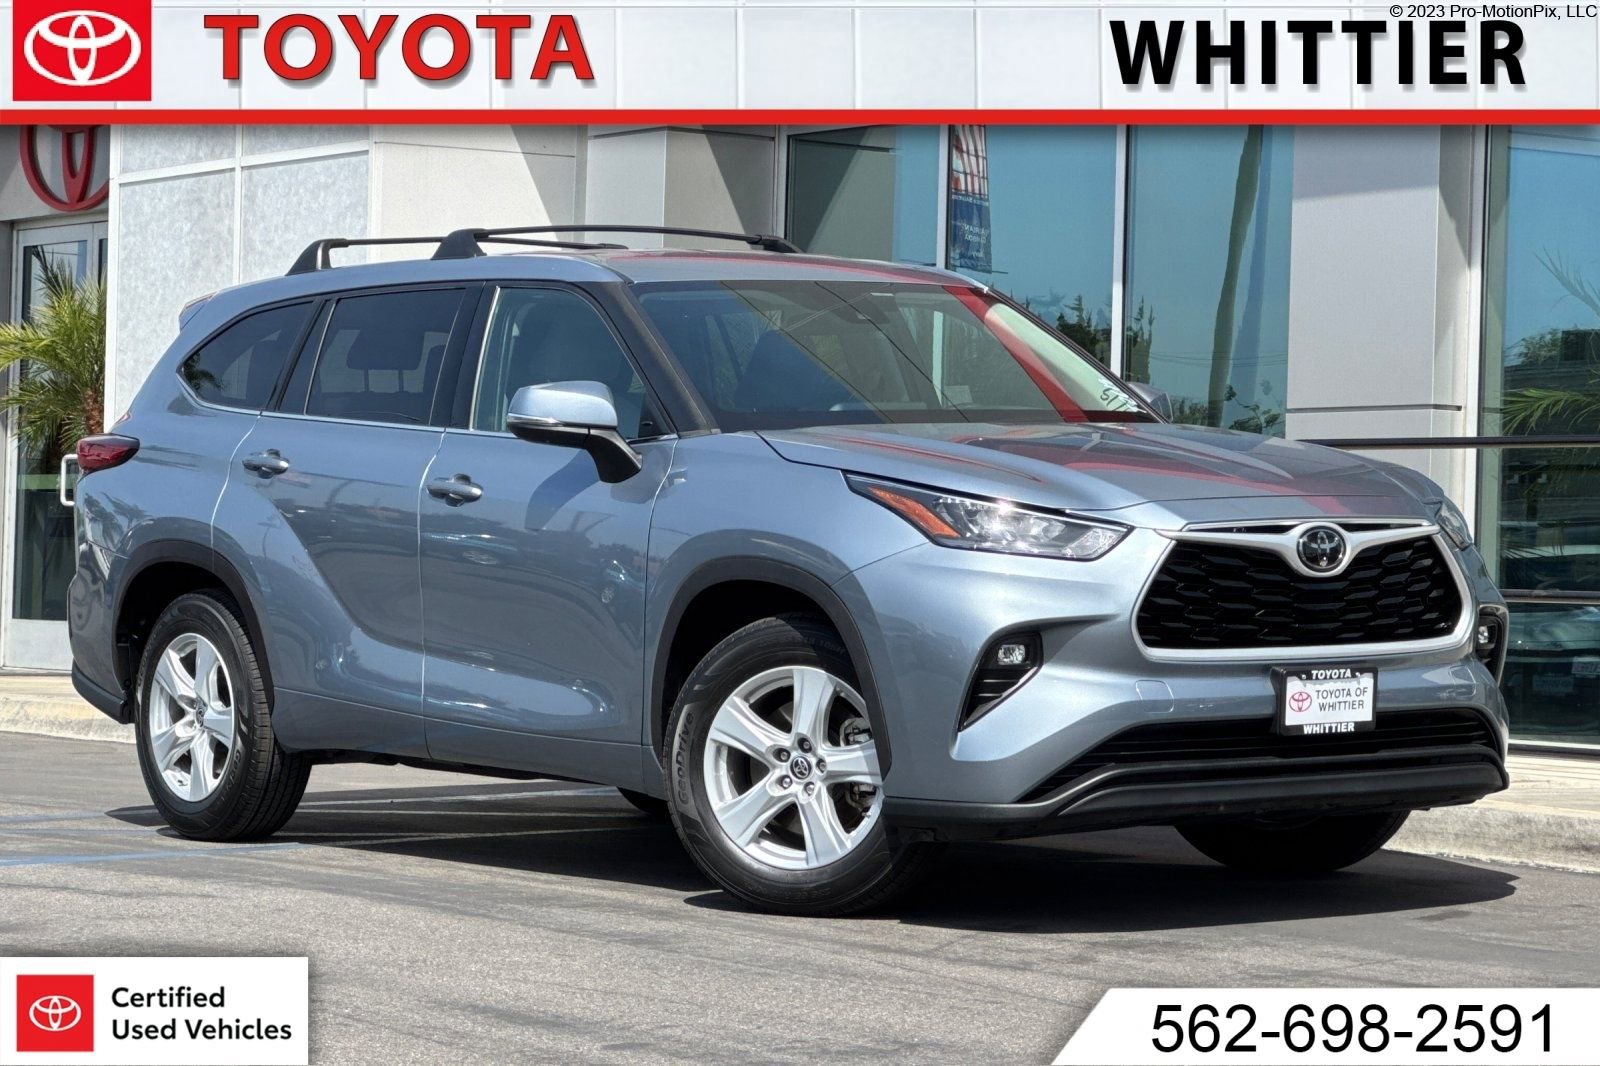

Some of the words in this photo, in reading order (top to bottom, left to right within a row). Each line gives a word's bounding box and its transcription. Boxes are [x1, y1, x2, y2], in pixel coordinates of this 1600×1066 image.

[1311, 668, 1352, 680] TOYOTA
[1315, 688, 1352, 700] TOYOTA
[1354, 686, 1369, 698] OF
[1318, 699, 1365, 713] WHITTIER
[1303, 721, 1355, 735] WHITTIER
